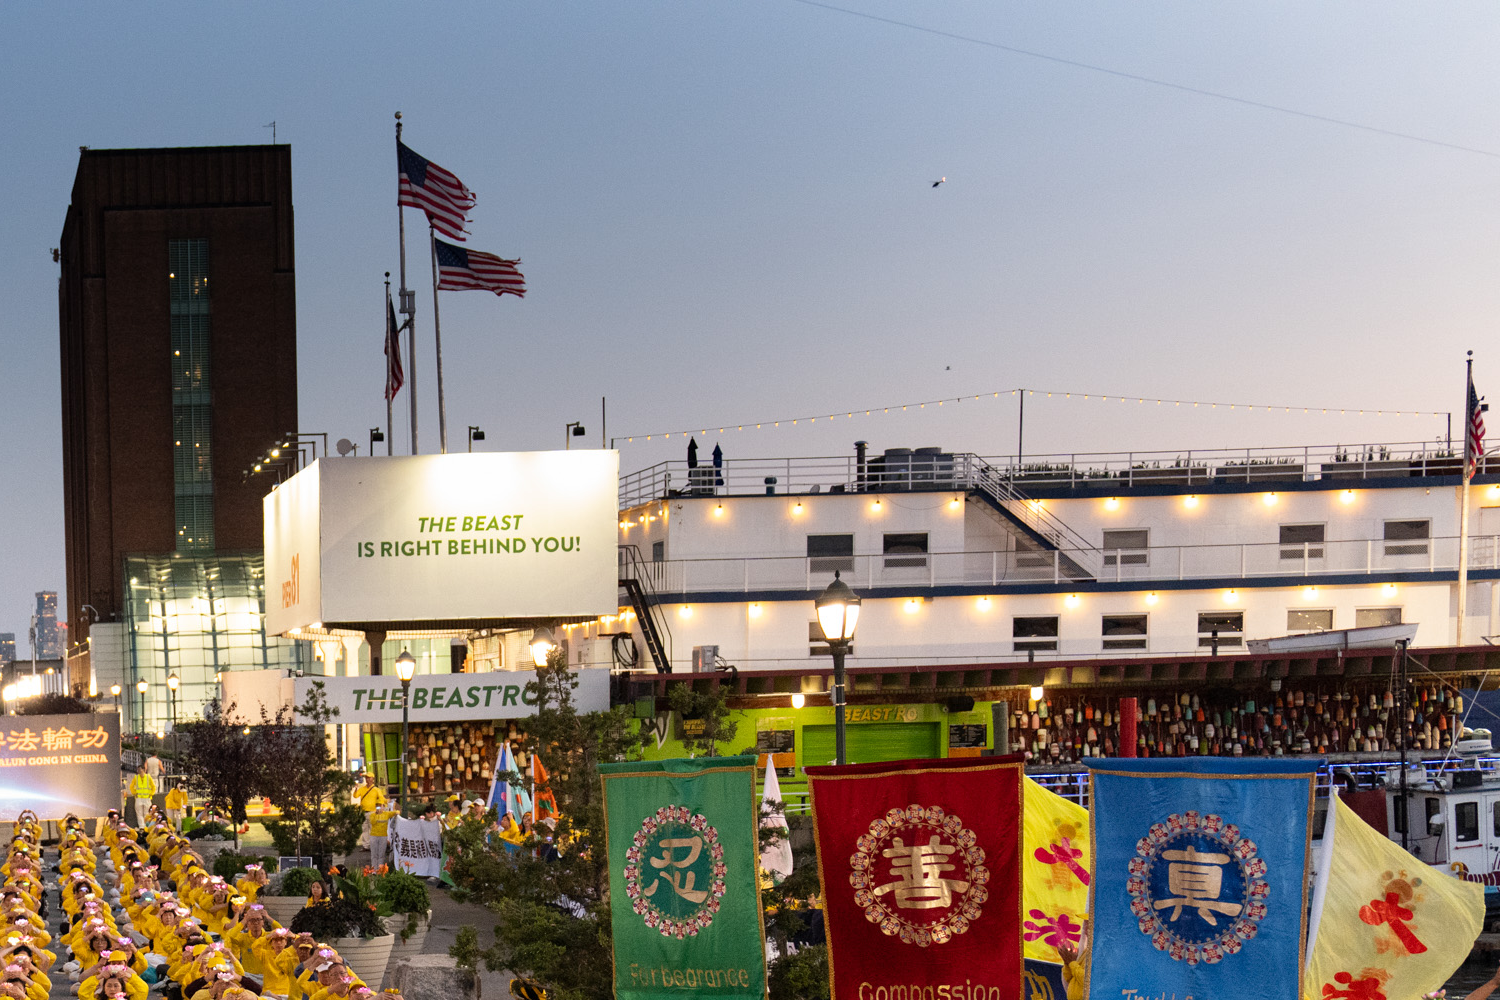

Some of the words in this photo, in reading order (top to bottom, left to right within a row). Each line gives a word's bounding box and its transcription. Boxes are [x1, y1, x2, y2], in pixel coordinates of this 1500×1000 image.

[418, 516, 457, 533] THE
[461, 514, 524, 532] BEAST
[357, 541, 375, 558] IS
[380, 540, 443, 557] RIGHT
[447, 537, 527, 555] BEHIND
[531, 536, 581, 553] YOU!
[291, 552, 300, 606] 81
[352, 689, 404, 711] THE
[28, 756, 59, 766] GONG
[60, 755, 72, 765] IN
[74, 754, 108, 764] CHINA
[644, 836, 709, 903] 忍
[874, 835, 969, 909] 善
[1152, 844, 1243, 926] 真
[630, 962, 750, 988] Forbearance
